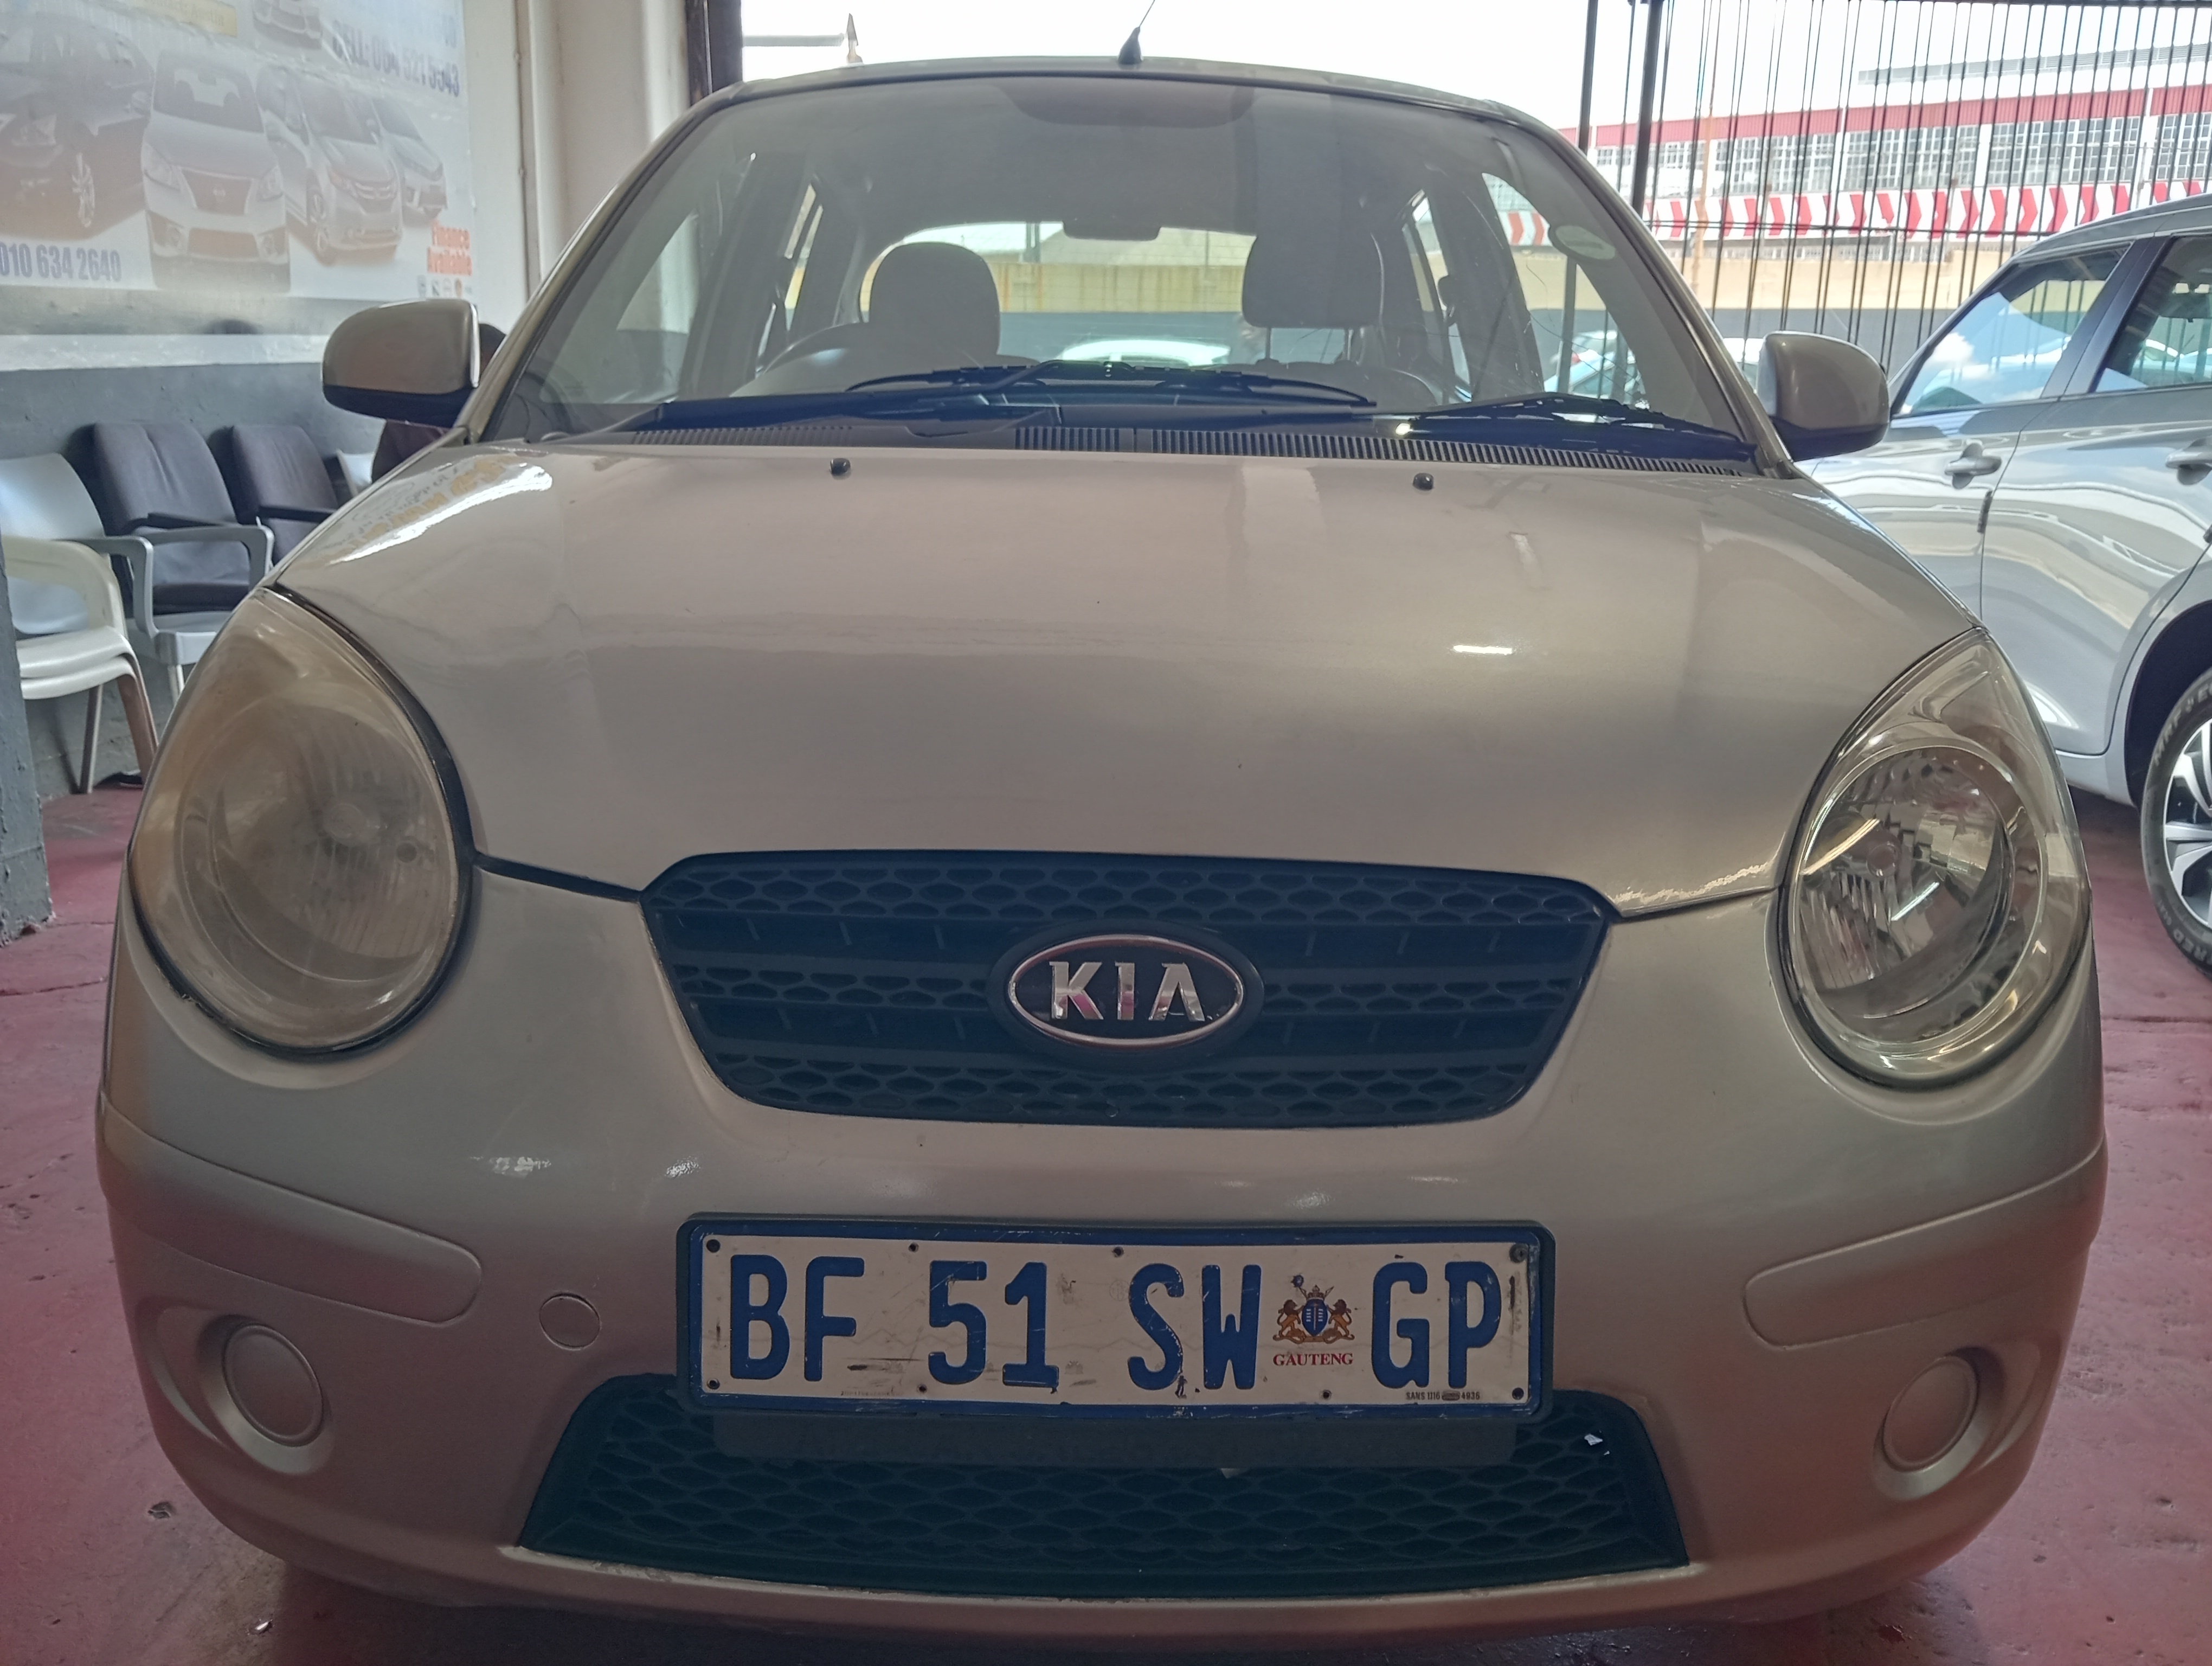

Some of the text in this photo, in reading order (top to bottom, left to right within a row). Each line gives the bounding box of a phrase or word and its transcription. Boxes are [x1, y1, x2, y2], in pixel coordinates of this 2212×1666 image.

[0, 241, 122, 282] 010 634 2640
[1049, 961, 1205, 1022] KIA
[730, 1253, 1502, 1391] BF 51 SW GP
[1272, 1353, 1354, 1366] GAUTENG
[1406, 1391, 1425, 1400] SANS
[1427, 1391, 1441, 1400] 1116
